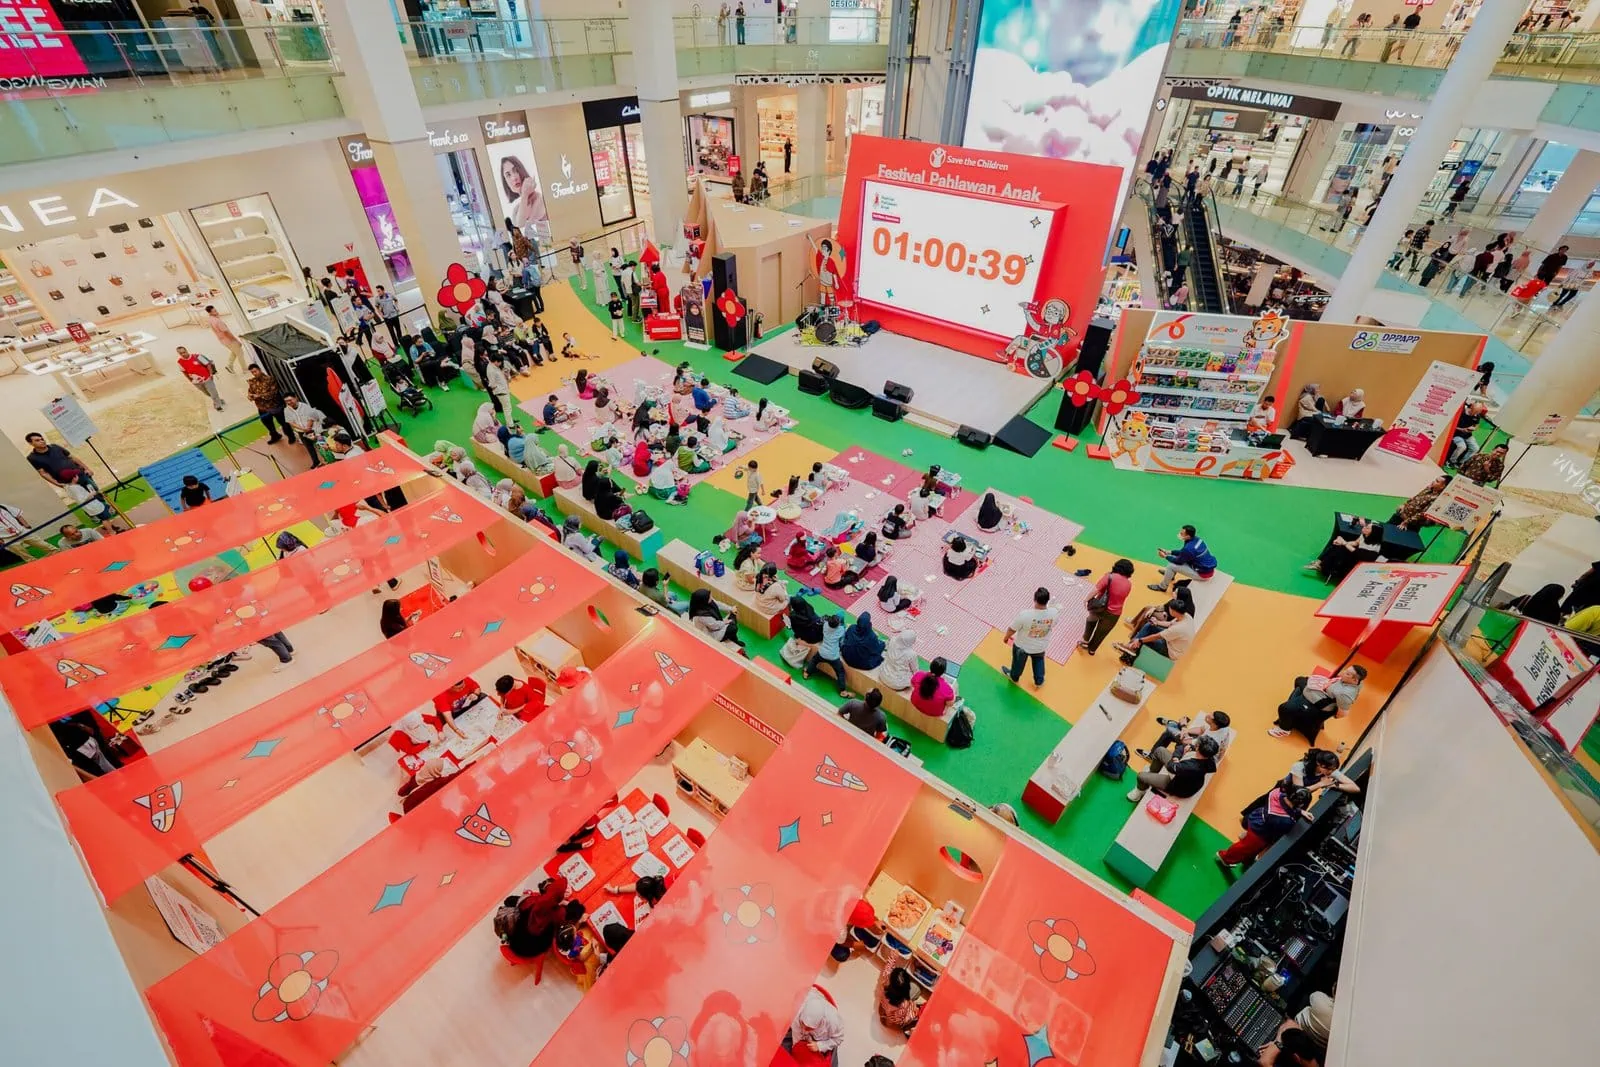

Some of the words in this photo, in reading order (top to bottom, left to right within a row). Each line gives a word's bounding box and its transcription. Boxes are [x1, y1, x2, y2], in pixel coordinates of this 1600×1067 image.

[0, 8, 63, 48] EE
[1206, 85, 1240, 100] OPTIK
[1240, 89, 1294, 109] MELAWAI
[485, 121, 512, 139] Frank
[946, 155, 963, 165] Save
[963, 157, 977, 167] the
[976, 158, 1009, 171] Children
[550, 180, 576, 198] Frank
[878, 164, 925, 185] Festival
[930, 171, 997, 196] Pahlawan
[1001, 182, 1042, 203] Anak
[872, 226, 1027, 286] 01:00:39
[1382, 333, 1421, 344] DPPAPP
[1394, 582, 1428, 611] Festival
